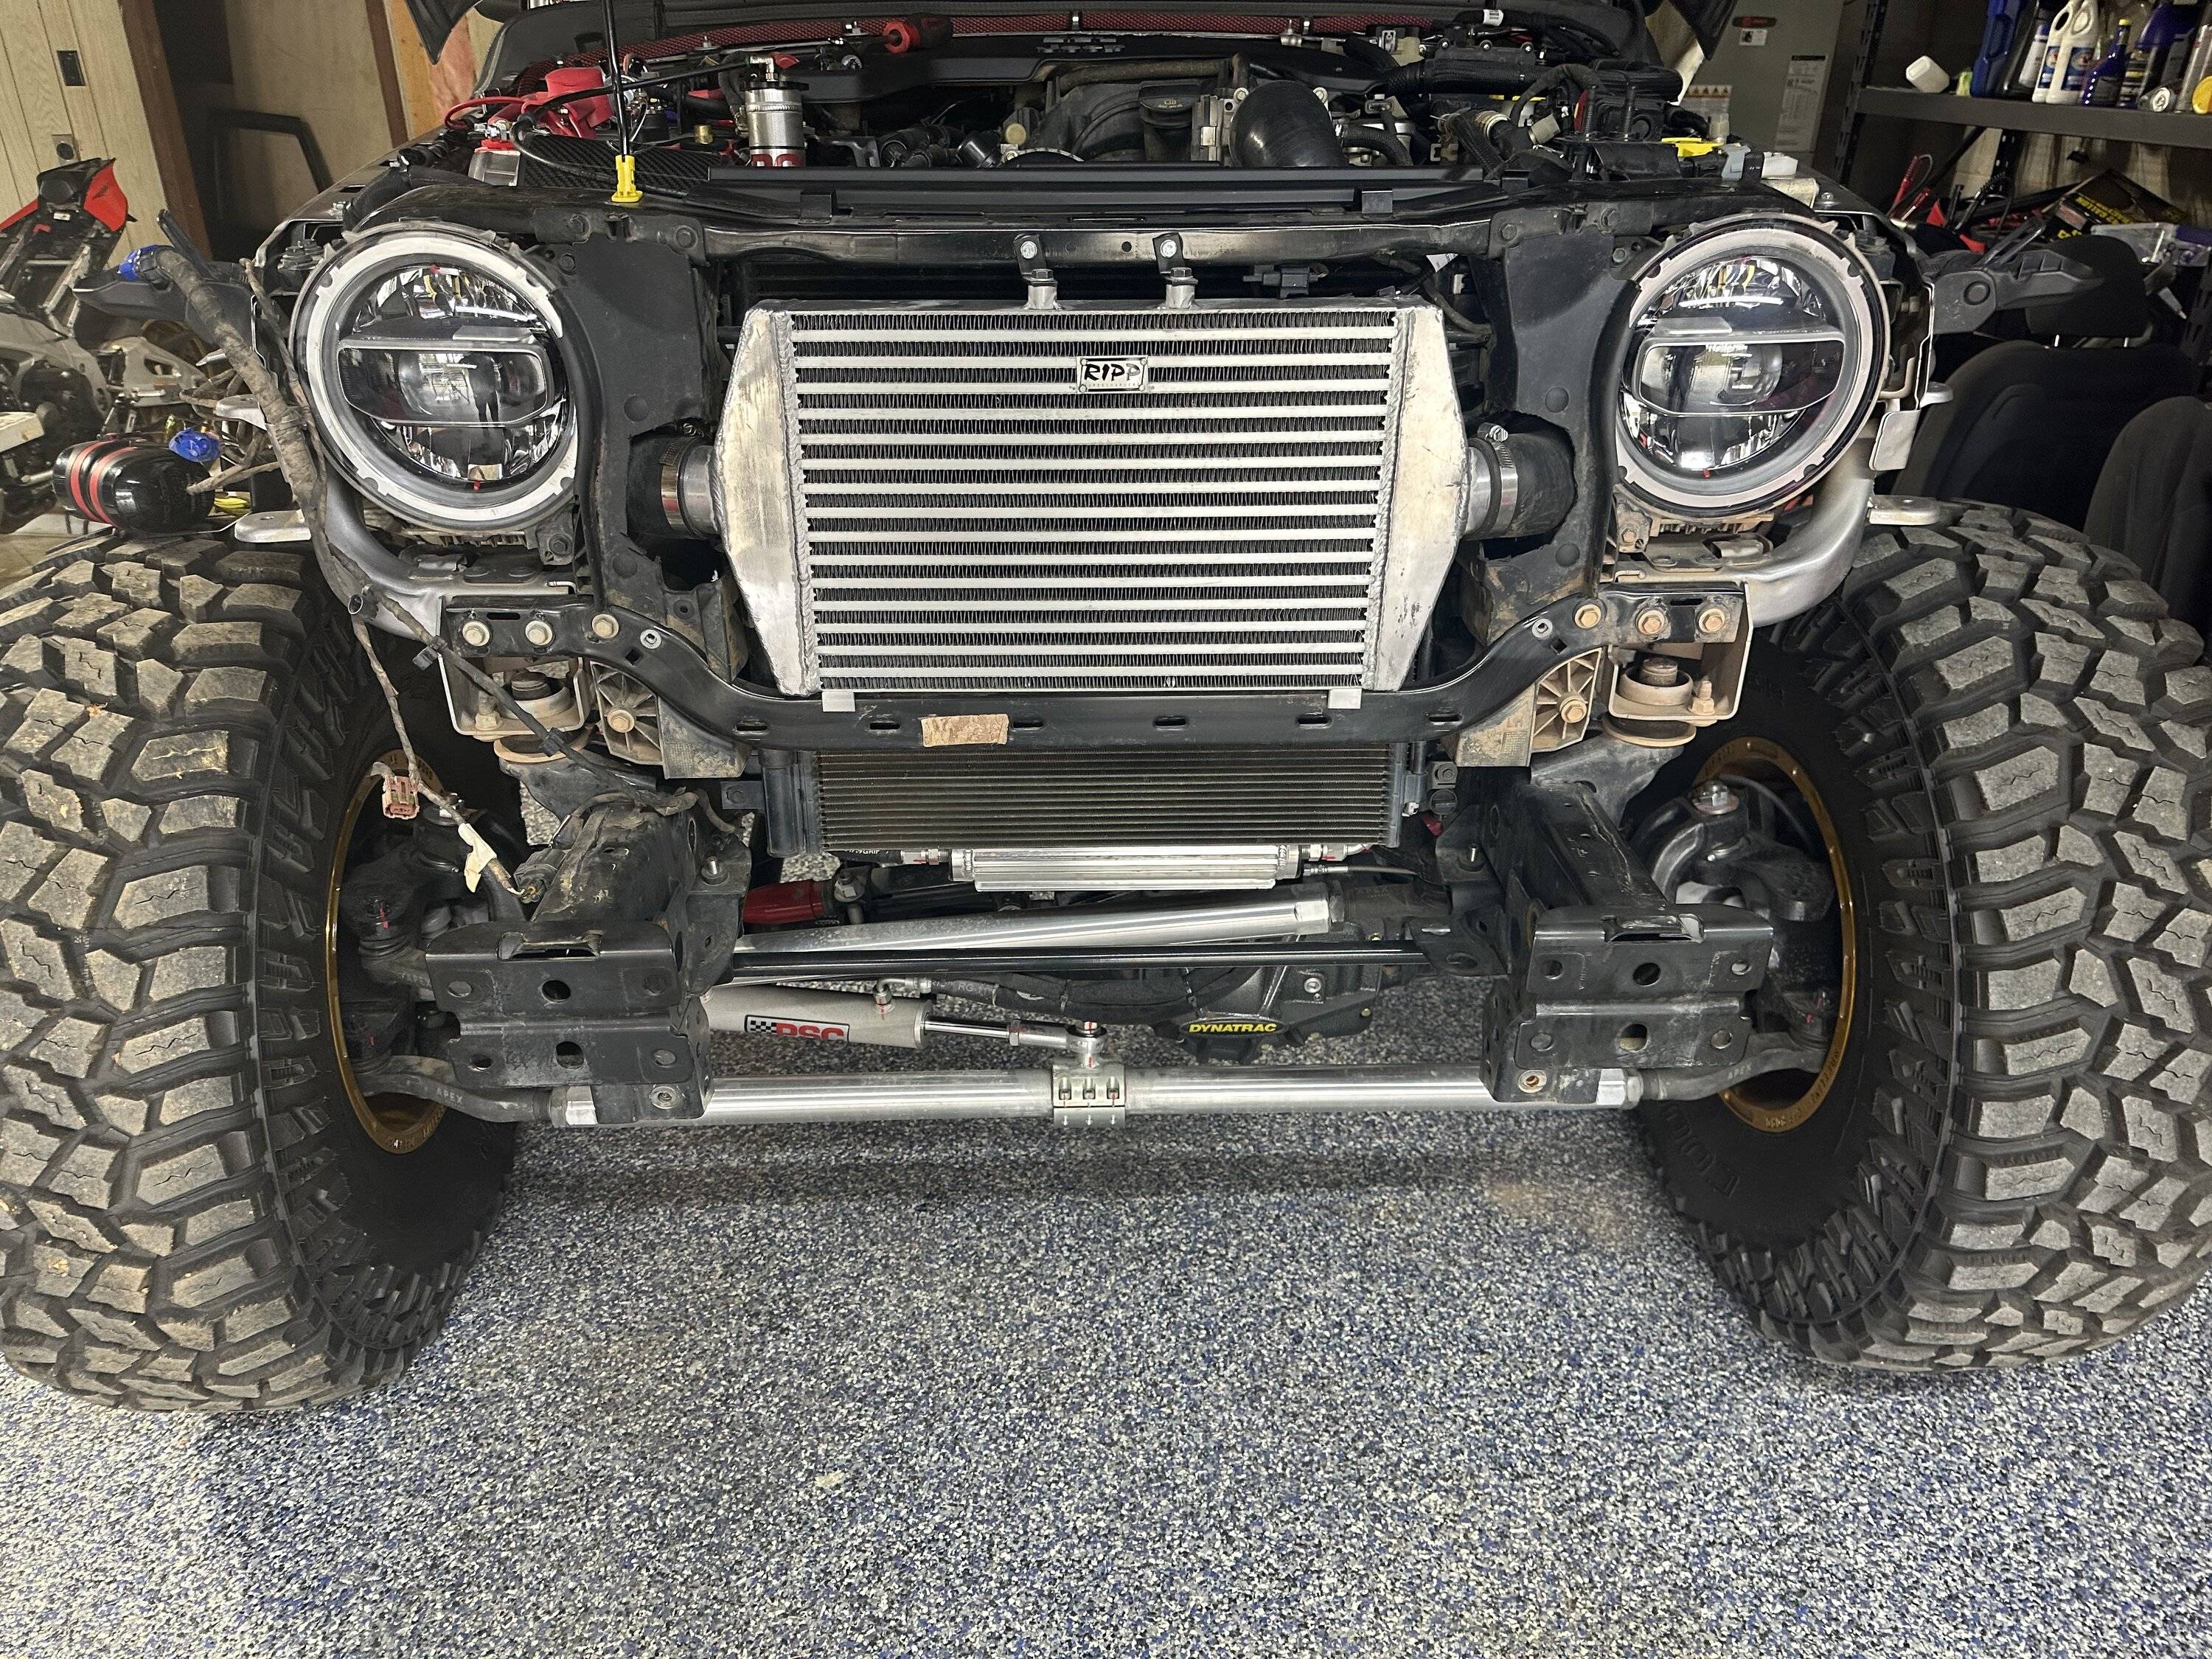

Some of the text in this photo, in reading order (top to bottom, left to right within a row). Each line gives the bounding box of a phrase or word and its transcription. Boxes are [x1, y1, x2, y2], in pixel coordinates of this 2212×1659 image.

[1084, 363, 1141, 381] RIPP
[1189, 1023, 1278, 1033] DYNATRAC
[436, 1087, 463, 1105] APEX
